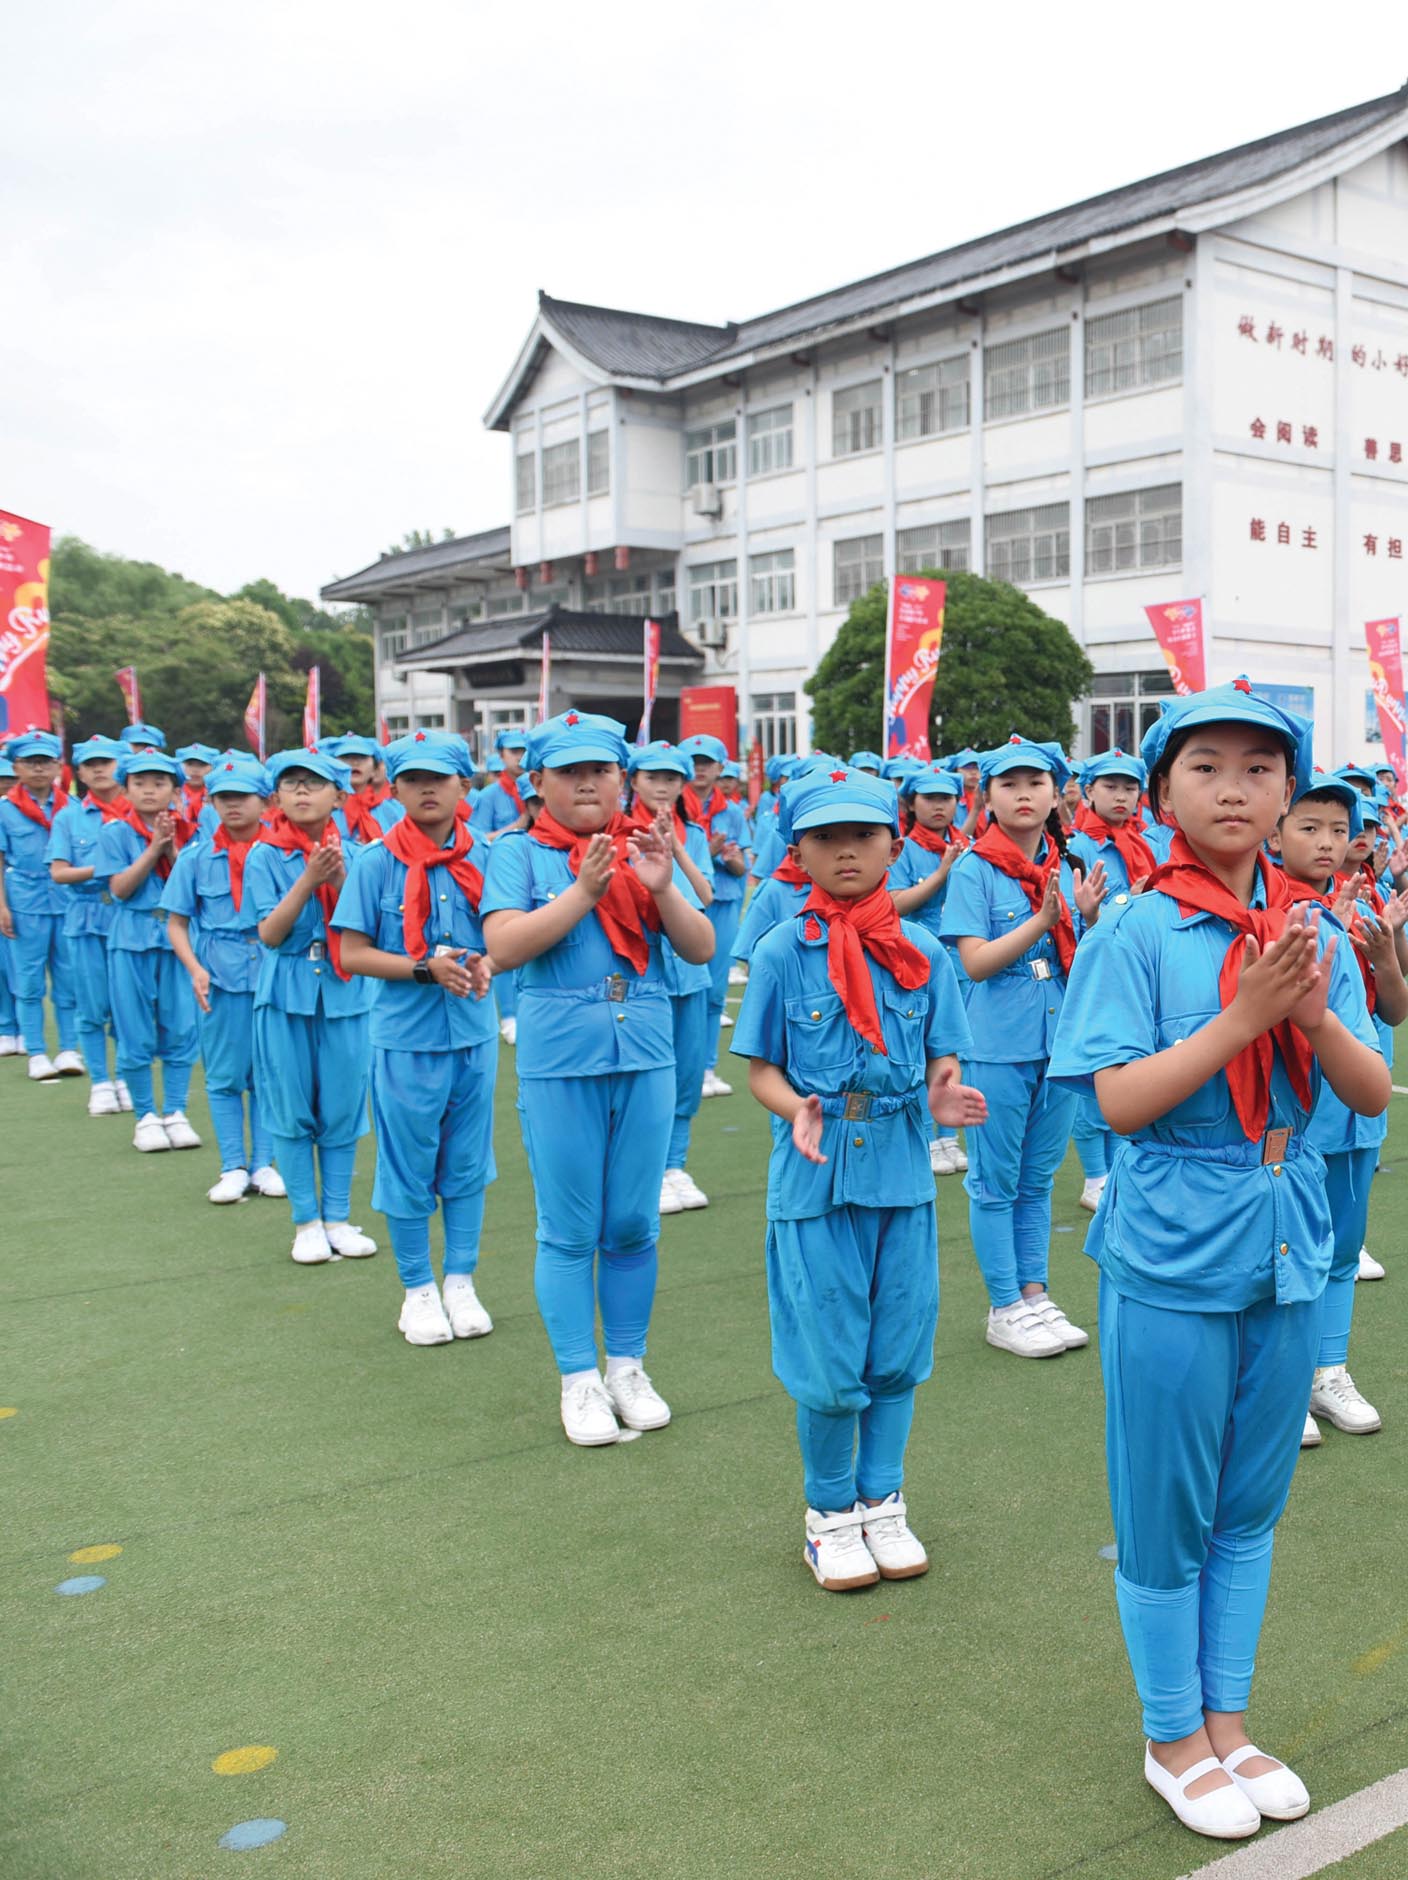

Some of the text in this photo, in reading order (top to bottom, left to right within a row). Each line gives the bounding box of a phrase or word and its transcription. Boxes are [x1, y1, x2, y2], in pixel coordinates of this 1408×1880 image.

[1237, 314, 1334, 362] 做新时期
[1249, 416, 1319, 448] 会阅读
[1249, 516, 1319, 550] 能自主
